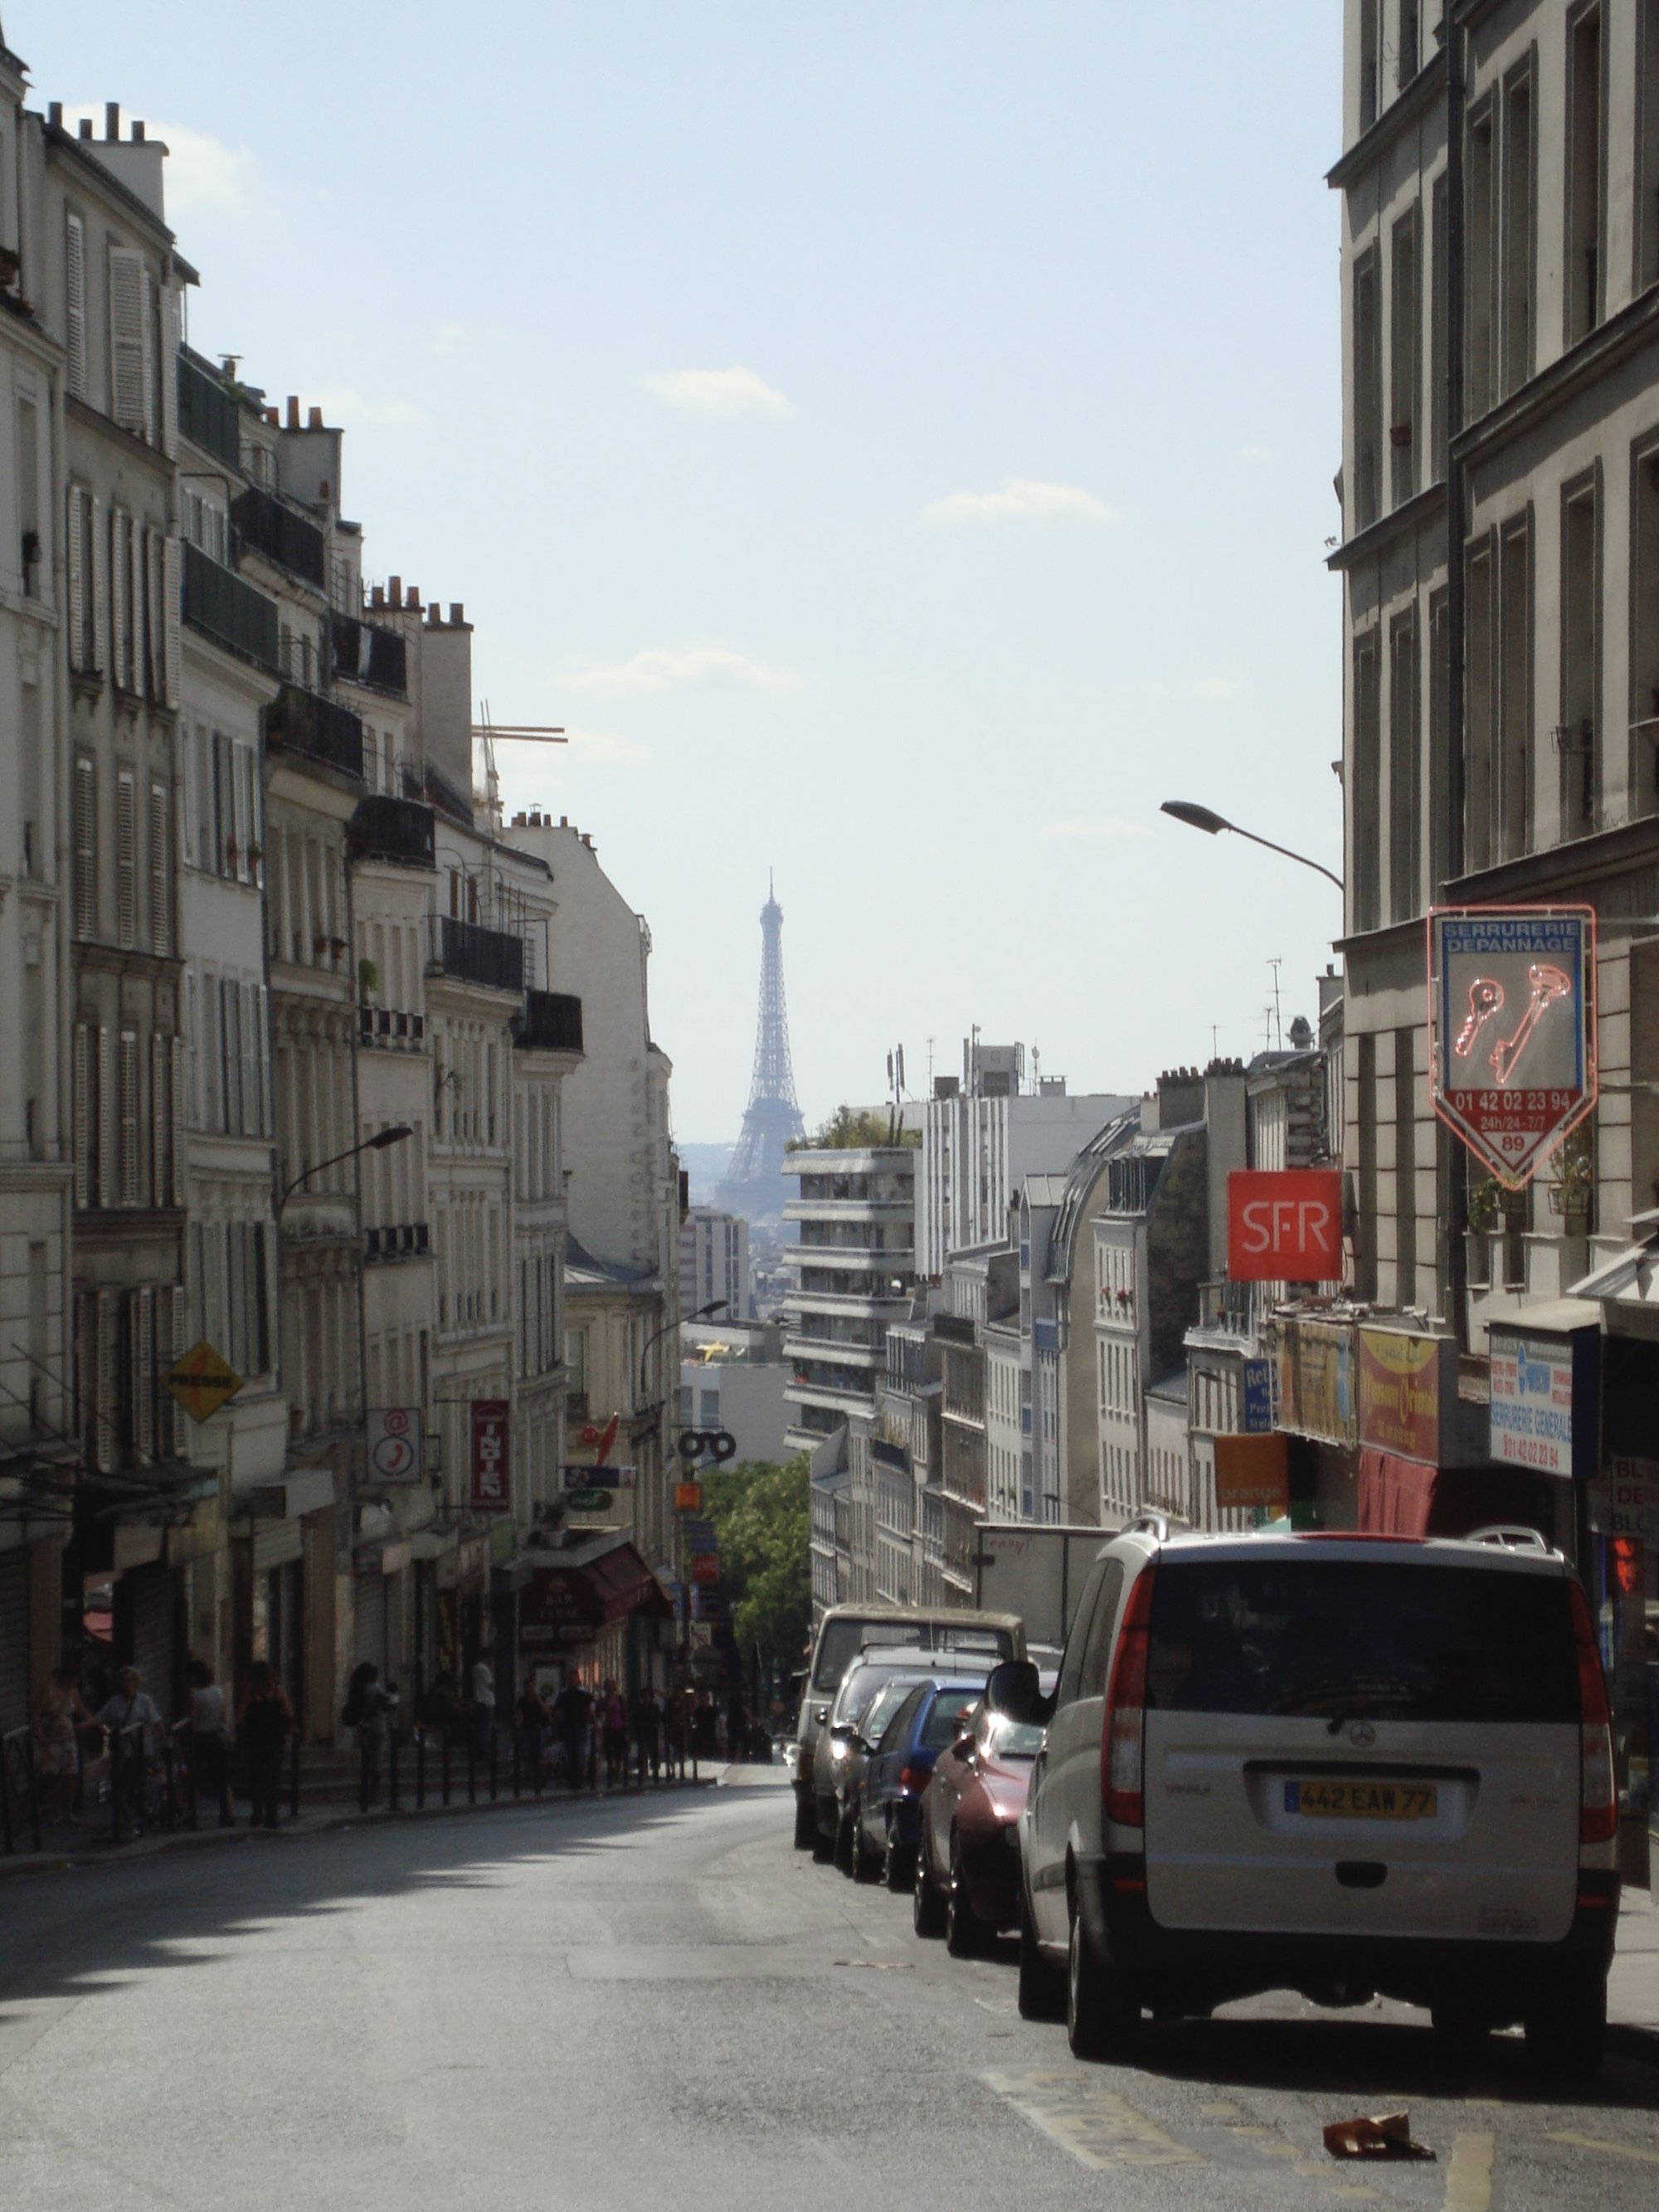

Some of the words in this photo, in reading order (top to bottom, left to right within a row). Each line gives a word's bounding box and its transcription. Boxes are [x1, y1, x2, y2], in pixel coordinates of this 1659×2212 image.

[1444, 923, 1579, 938] SERRURERIE
[1447, 938, 1576, 953] DEPANNAGE
[1456, 1093, 1473, 1111] 01
[1479, 1093, 1499, 1111] 42
[1503, 1093, 1522, 1111] 02
[1527, 1093, 1546, 1111] 23
[1551, 1093, 1571, 1111] 94
[1501, 1136, 1525, 1152] 89
[1242, 1200, 1331, 1254] SFR
[168, 1374, 233, 1388] PRESSE
[1535, 1408, 1573, 1444] GENERALE
[479, 1424, 502, 1497] INDIEN
[1519, 1439, 1527, 1461] 42
[1528, 1440, 1538, 1464] 02
[1539, 1444, 1548, 1467] 23
[1550, 1446, 1559, 1469] 94
[1221, 1487, 1282, 1503] orange
[1301, 1788, 1346, 1811] 442
[1351, 1790, 1395, 1812] EAW
[1400, 1791, 1433, 1814] 77
